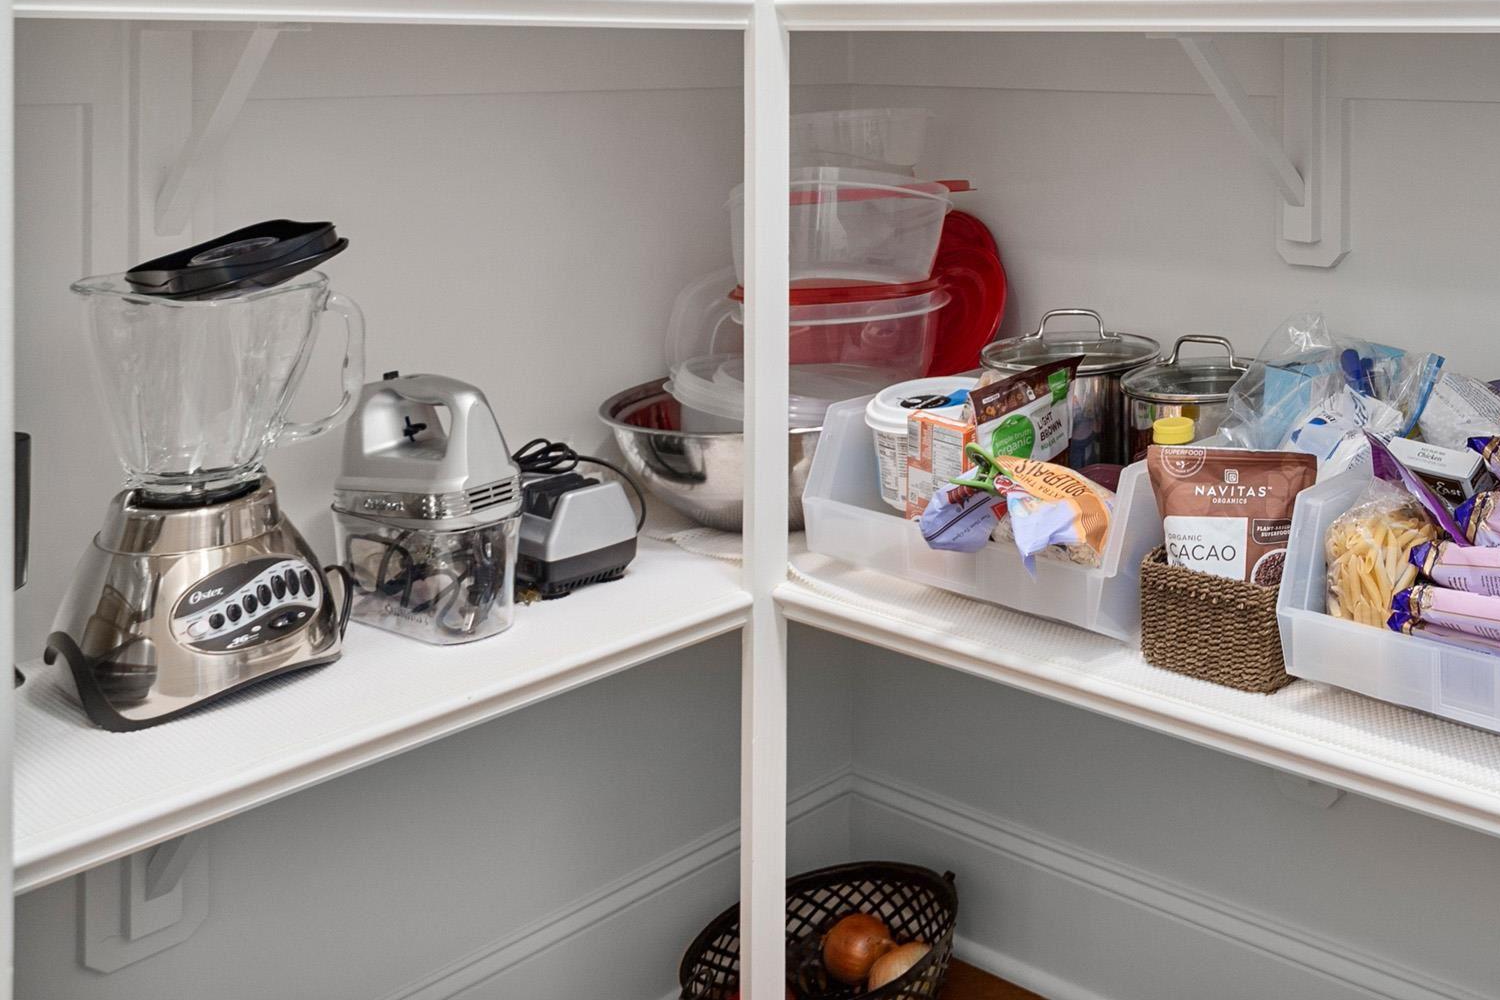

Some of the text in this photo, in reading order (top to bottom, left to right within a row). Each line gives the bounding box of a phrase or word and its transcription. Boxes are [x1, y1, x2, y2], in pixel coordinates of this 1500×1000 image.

[1036, 408, 1054, 431] LIGHT
[1039, 420, 1064, 443] BROWN
[997, 437, 1033, 462] organic
[1163, 448, 1205, 457] SUPERFOOD
[1416, 451, 1443, 463] Chicken
[1211, 497, 1248, 505] ORGANICS
[1167, 532, 1203, 543] ORGANIC
[1168, 541, 1237, 562] CACAO
[188, 587, 223, 605] Oster
